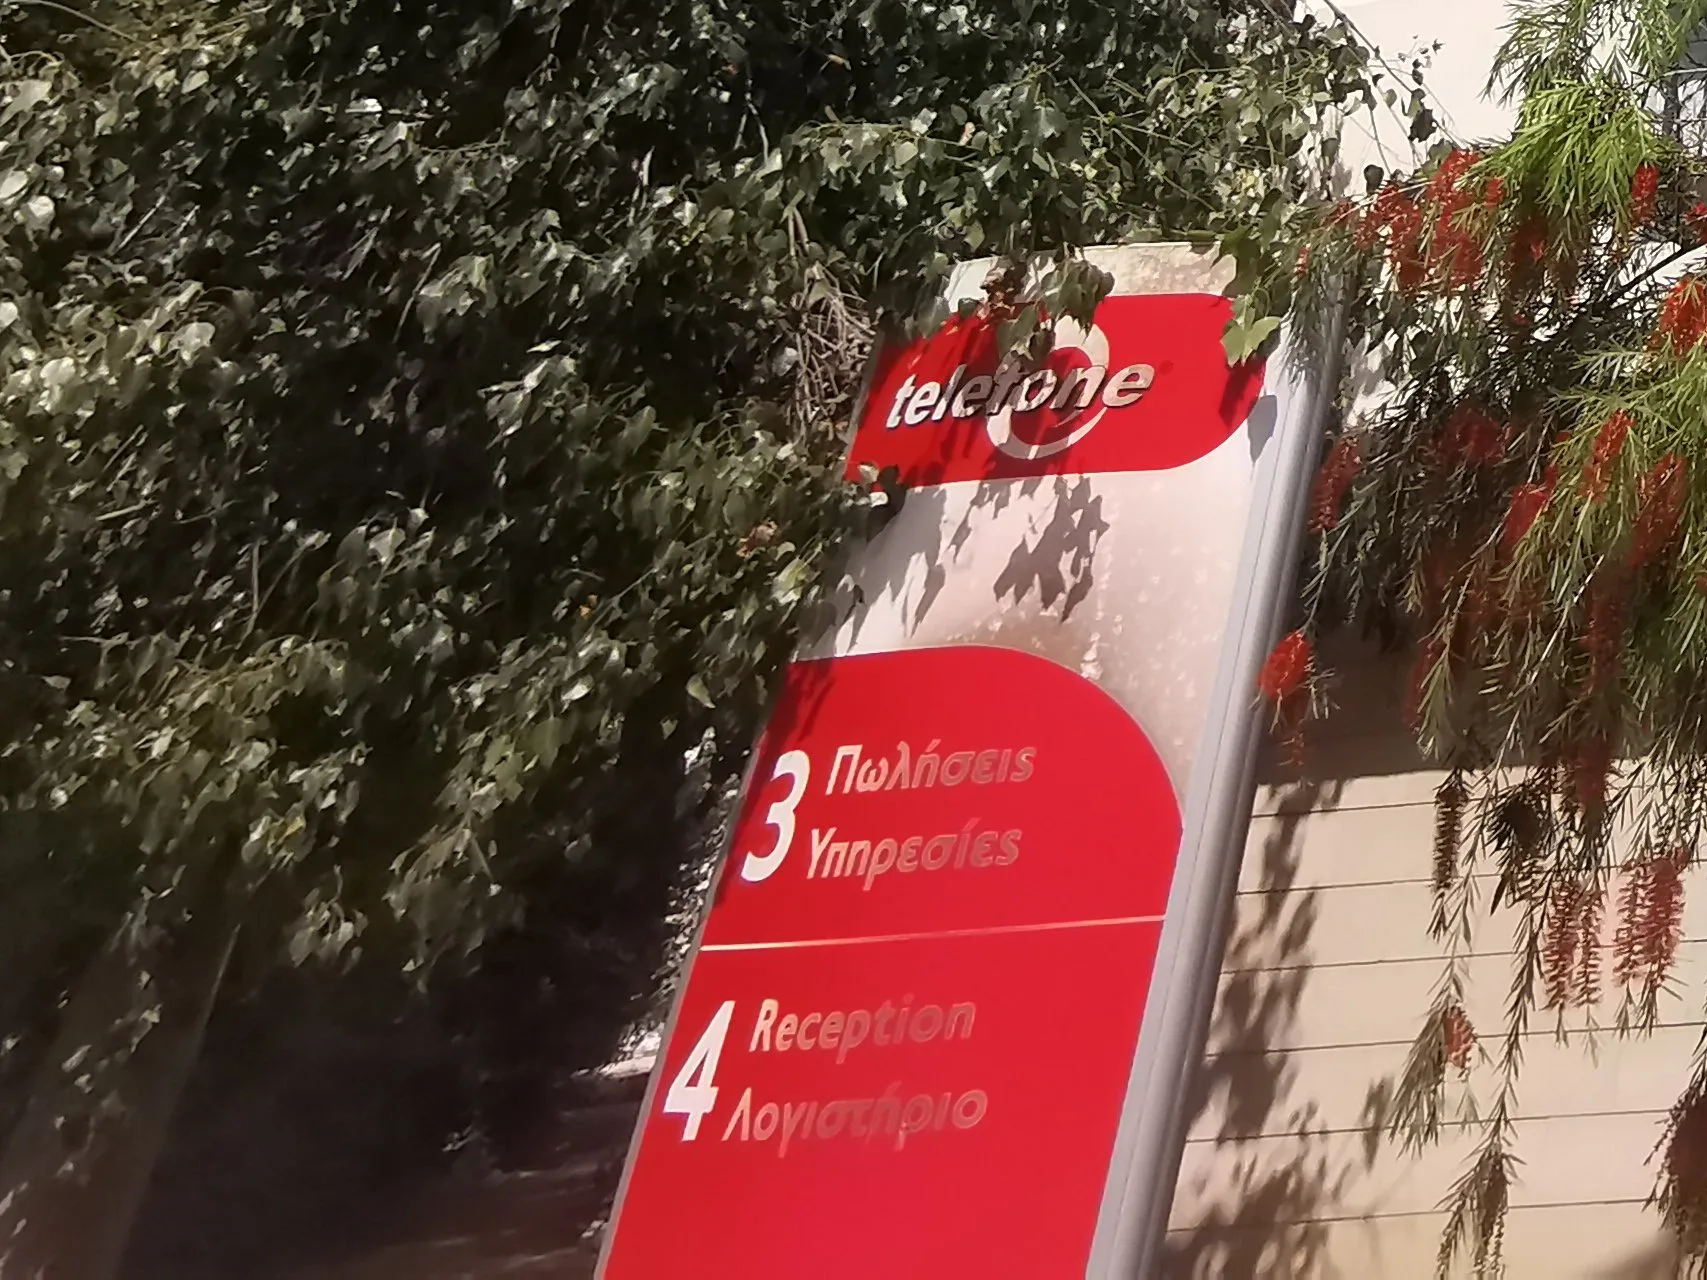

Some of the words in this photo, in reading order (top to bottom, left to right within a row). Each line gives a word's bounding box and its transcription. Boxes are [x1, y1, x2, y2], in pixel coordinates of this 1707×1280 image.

[825, 739, 1038, 796] Πωλήσεις
[740, 749, 811, 883] 3
[806, 817, 1023, 892] Υπηρεσίες
[748, 992, 977, 1065] Reception
[662, 999, 736, 1142] 4
[720, 1081, 989, 1159] Λογιστήριο
